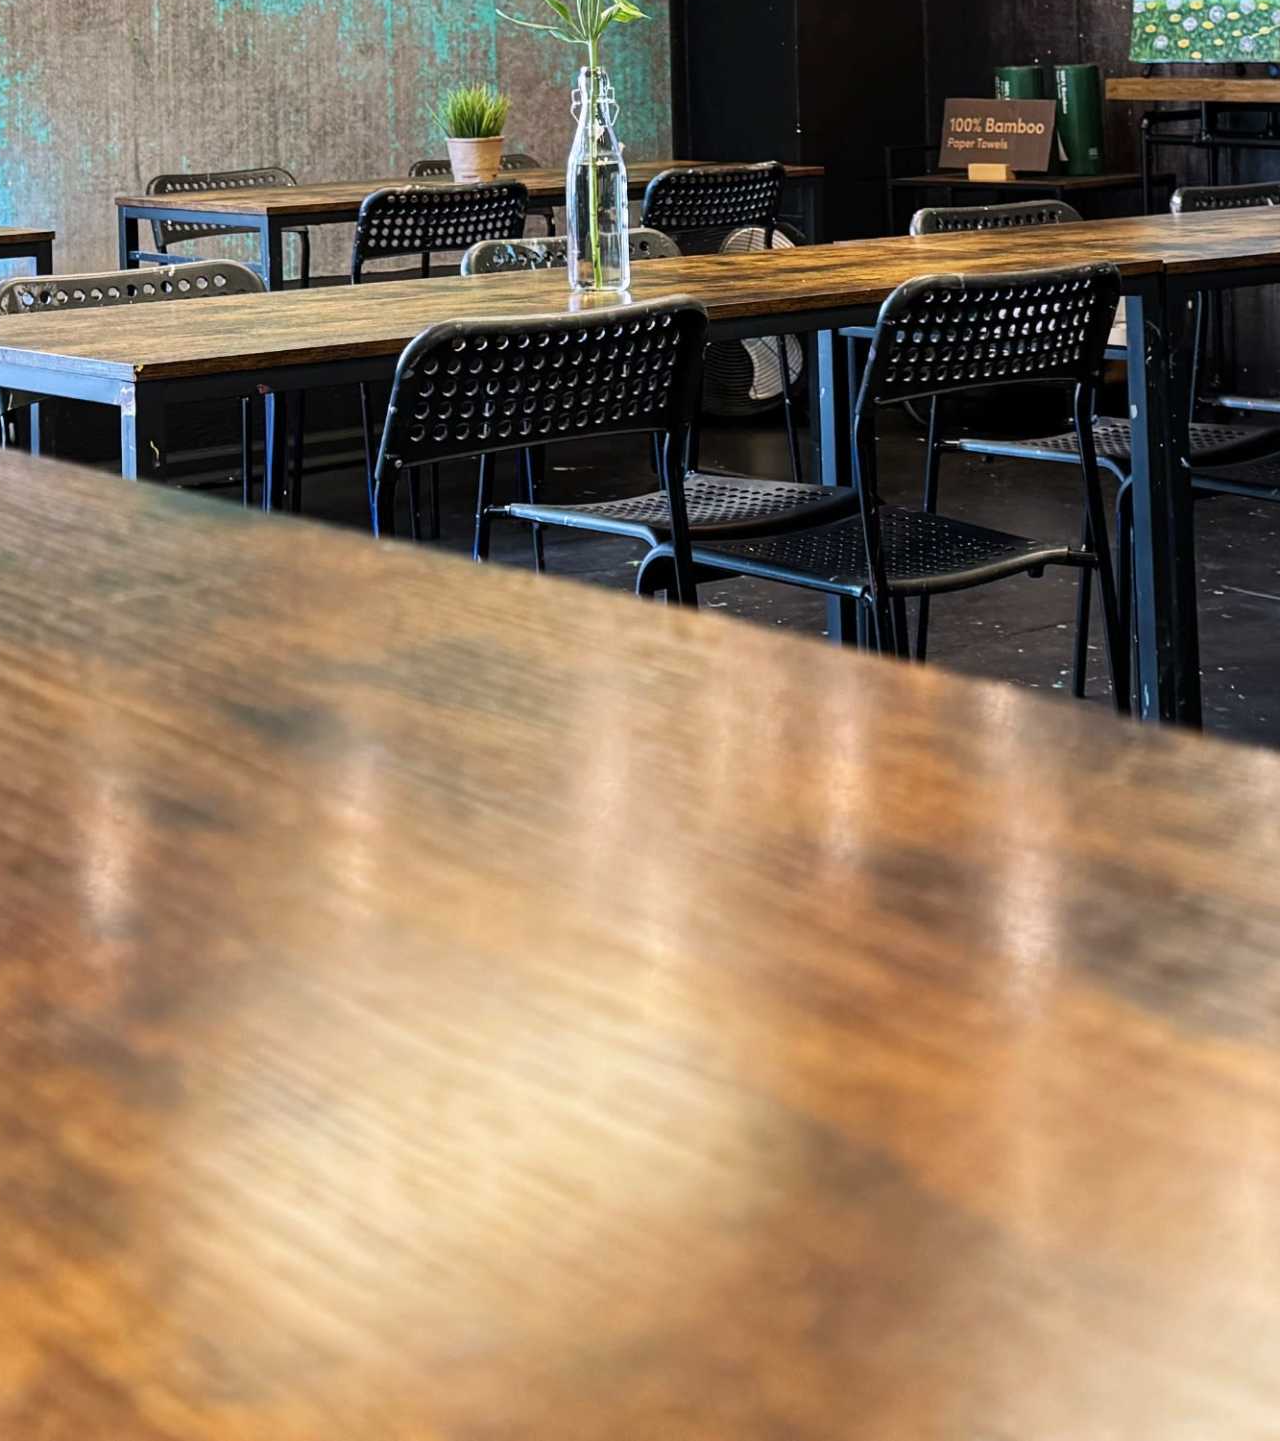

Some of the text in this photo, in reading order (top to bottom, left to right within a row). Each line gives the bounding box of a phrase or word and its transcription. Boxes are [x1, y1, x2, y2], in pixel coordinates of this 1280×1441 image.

[949, 117, 1045, 135] 100% Bamboo
[947, 137, 1009, 151] Paper Towels
